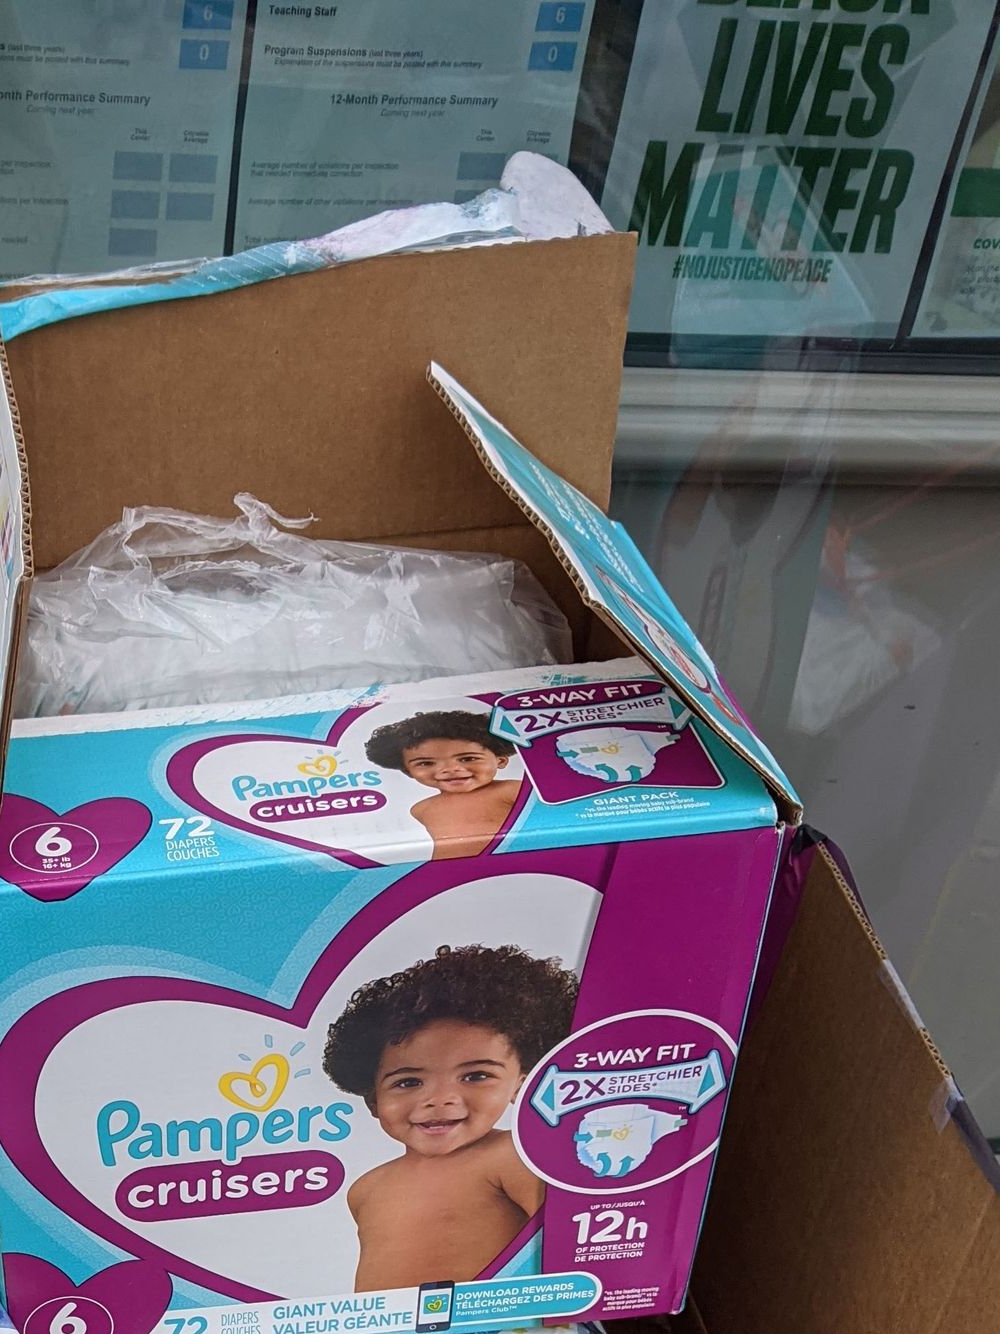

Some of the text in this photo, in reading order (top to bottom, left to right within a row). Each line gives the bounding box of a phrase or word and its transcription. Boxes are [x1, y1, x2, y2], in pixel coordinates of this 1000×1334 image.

[203, 5, 213, 21] 6
[269, 5, 337, 17] Teaching Staff
[556, 7, 566, 23] 6
[200, 44, 209, 60] 0
[264, 45, 304, 56] Program
[307, 46, 367, 58] Suspensions
[548, 47, 558, 62] 0
[695, 17, 910, 138] LIVES
[26, 90, 96, 102] Performance
[99, 92, 151, 105] Summary
[330, 94, 498, 108] 12-Month Performance Summary
[628, 139, 914, 255] MATTER
[973, 238, 1000, 249] COV
[672, 254, 833, 284] #NOJUSTICENOPEACE
[517, 683, 643, 708] 3-WAY FIT
[566, 697, 666, 717] STRETCHIER
[515, 710, 570, 733] 2X
[231, 769, 383, 802] Pampers
[256, 793, 378, 817] cruisers
[594, 791, 679, 806] GIANT PACK
[159, 816, 215, 840] 72
[35, 827, 72, 857] 6
[166, 836, 215, 851] DIAPERS
[166, 846, 220, 862] COUCHES
[574, 1043, 696, 1068] 3-WAY FIT
[609, 1065, 703, 1085] STRETCHIER
[559, 1077, 606, 1105] 2X
[97, 1099, 354, 1167] Pampers
[127, 1166, 329, 1208] cruisers
[572, 1210, 648, 1245] 12h
[574, 1251, 643, 1263] DE PROTECTION
[575, 1242, 645, 1254] OF PROTECTION
[456, 1282, 574, 1301] DOWNLOAD REWARDS
[456, 1293, 530, 1310] TÉLÉCHARGEZ
[533, 1292, 553, 1303] DES
[555, 1289, 594, 1301] PRIMES
[273, 1296, 385, 1320] GIANT VALUE
[456, 1306, 491, 1317] Pampers
[221, 1311, 259, 1327] DIAPERS
[343, 1310, 413, 1331] GÉANTE
